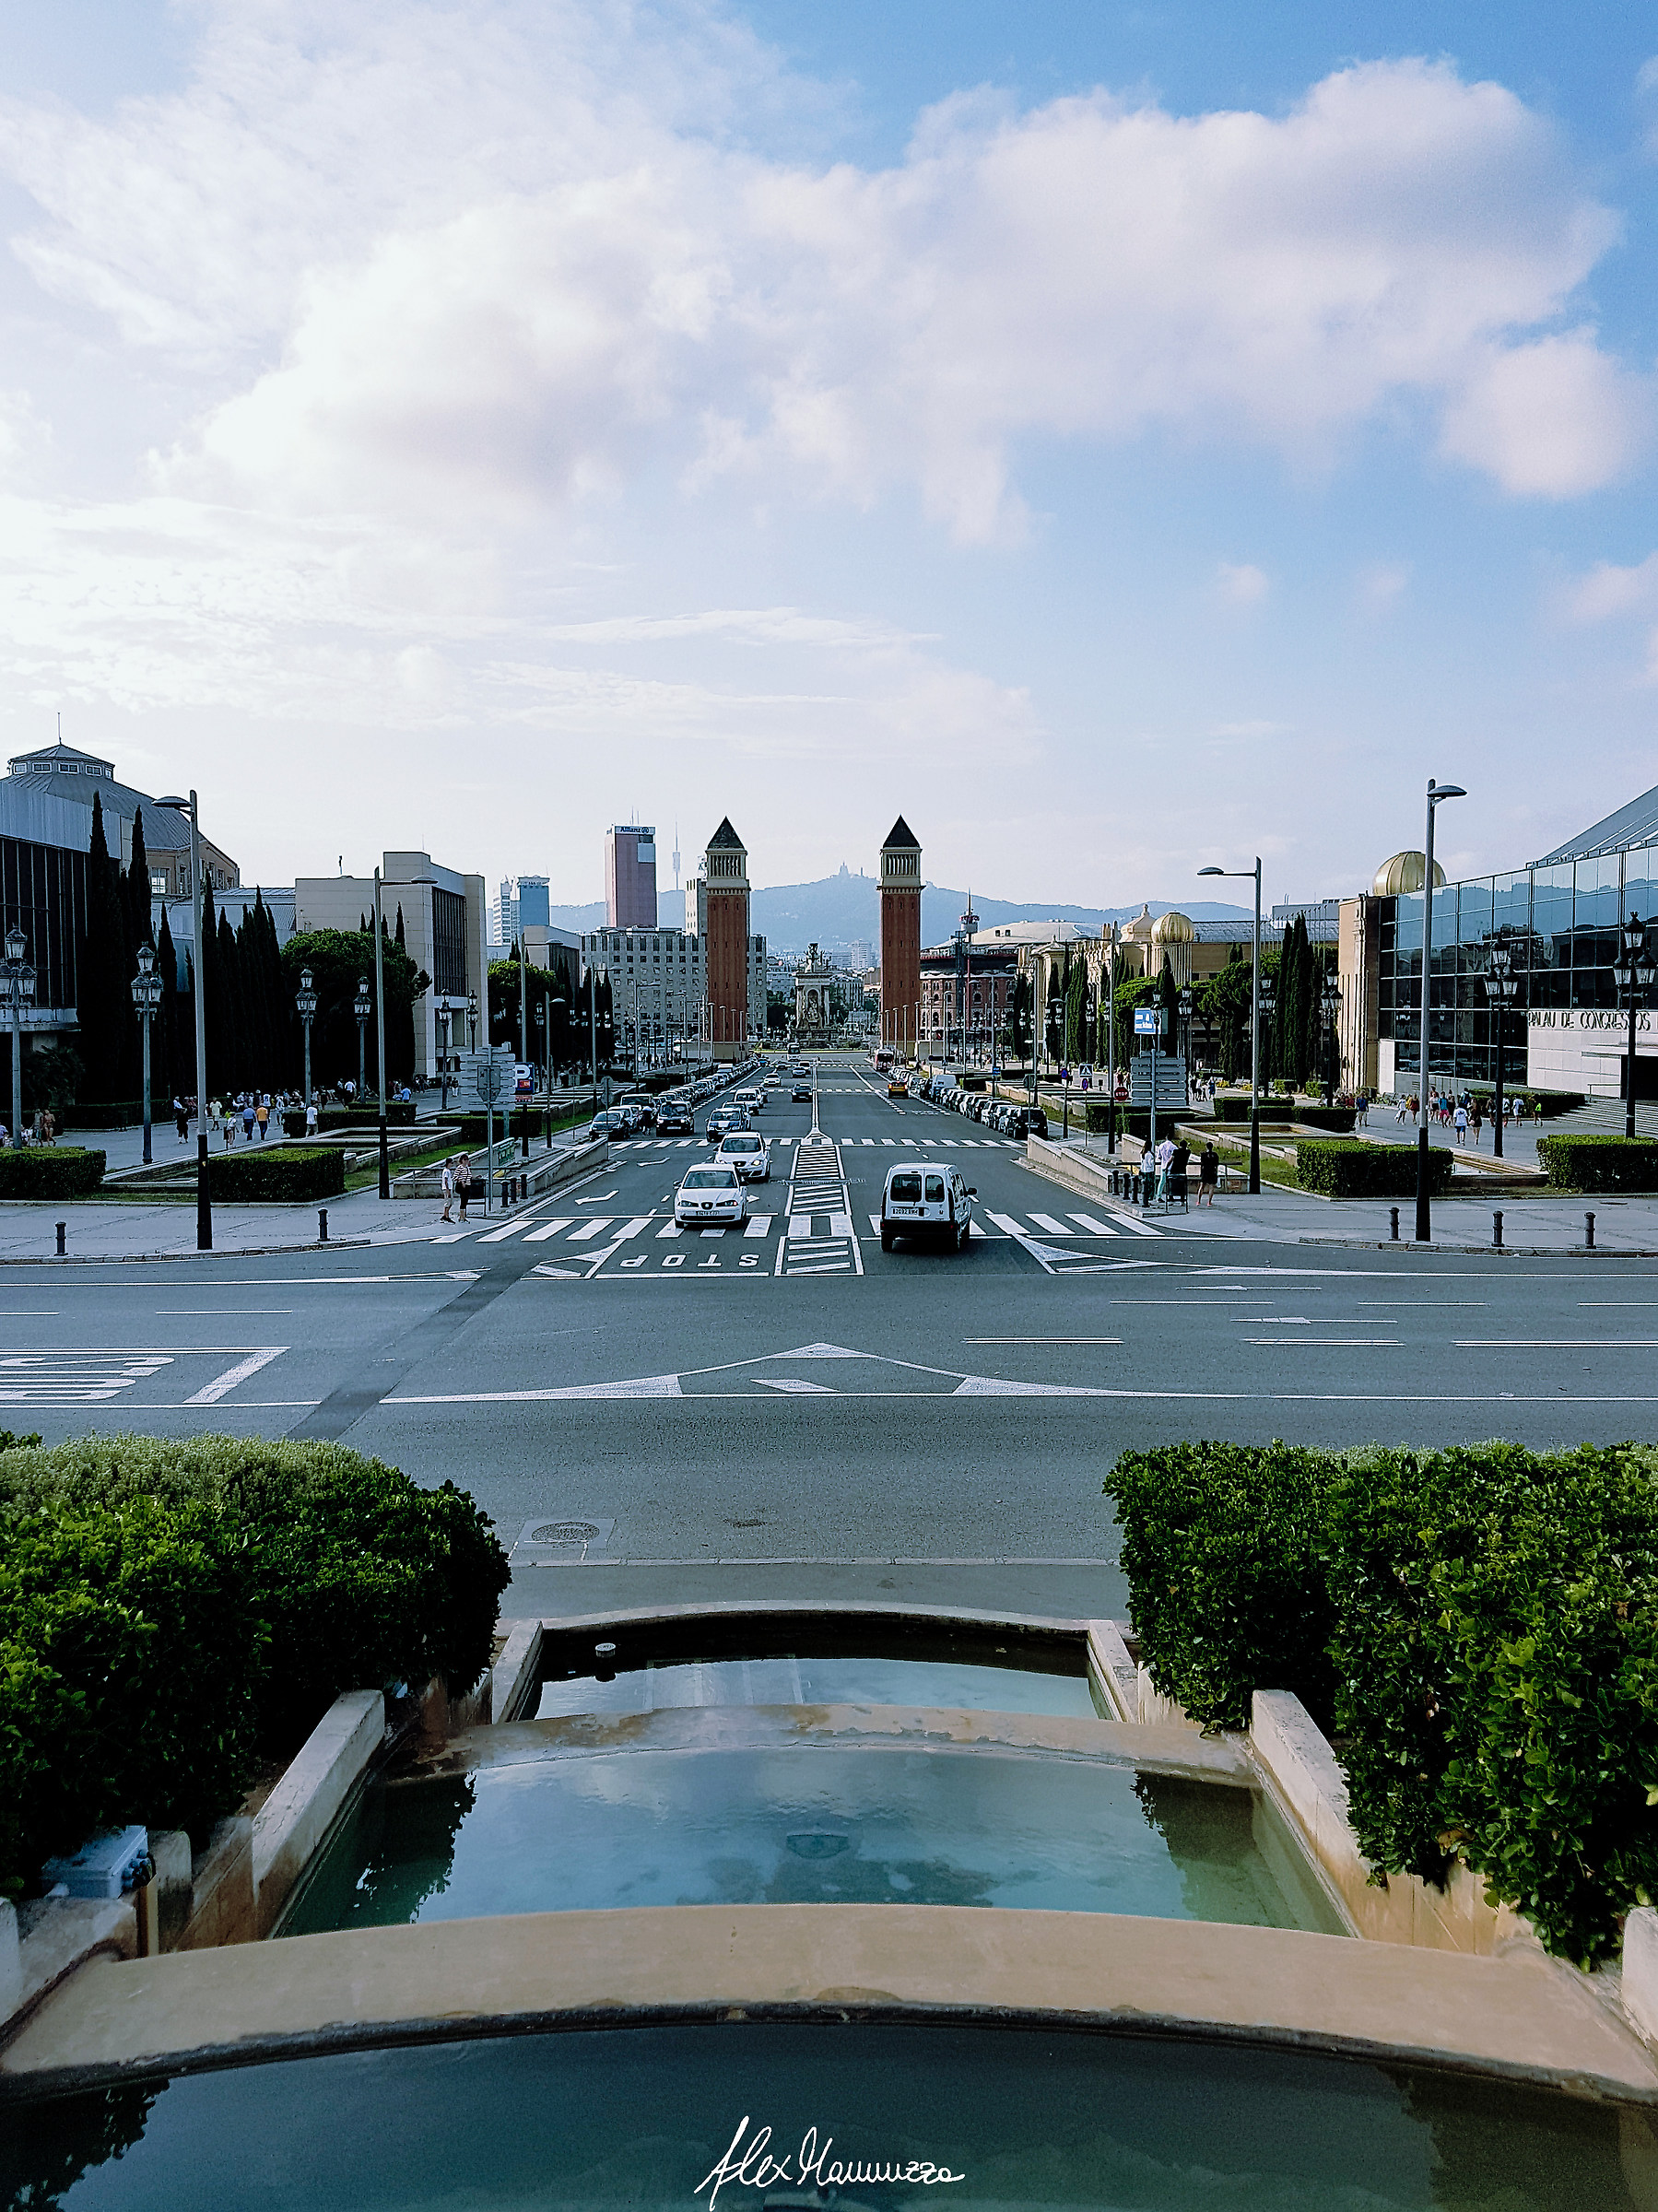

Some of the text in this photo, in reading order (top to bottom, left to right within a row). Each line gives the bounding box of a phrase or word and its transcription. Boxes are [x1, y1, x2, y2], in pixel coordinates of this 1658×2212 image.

[1528, 1010, 1652, 1031] PALAU DE CONGRESOS
[619, 1253, 759, 1268] STOP
